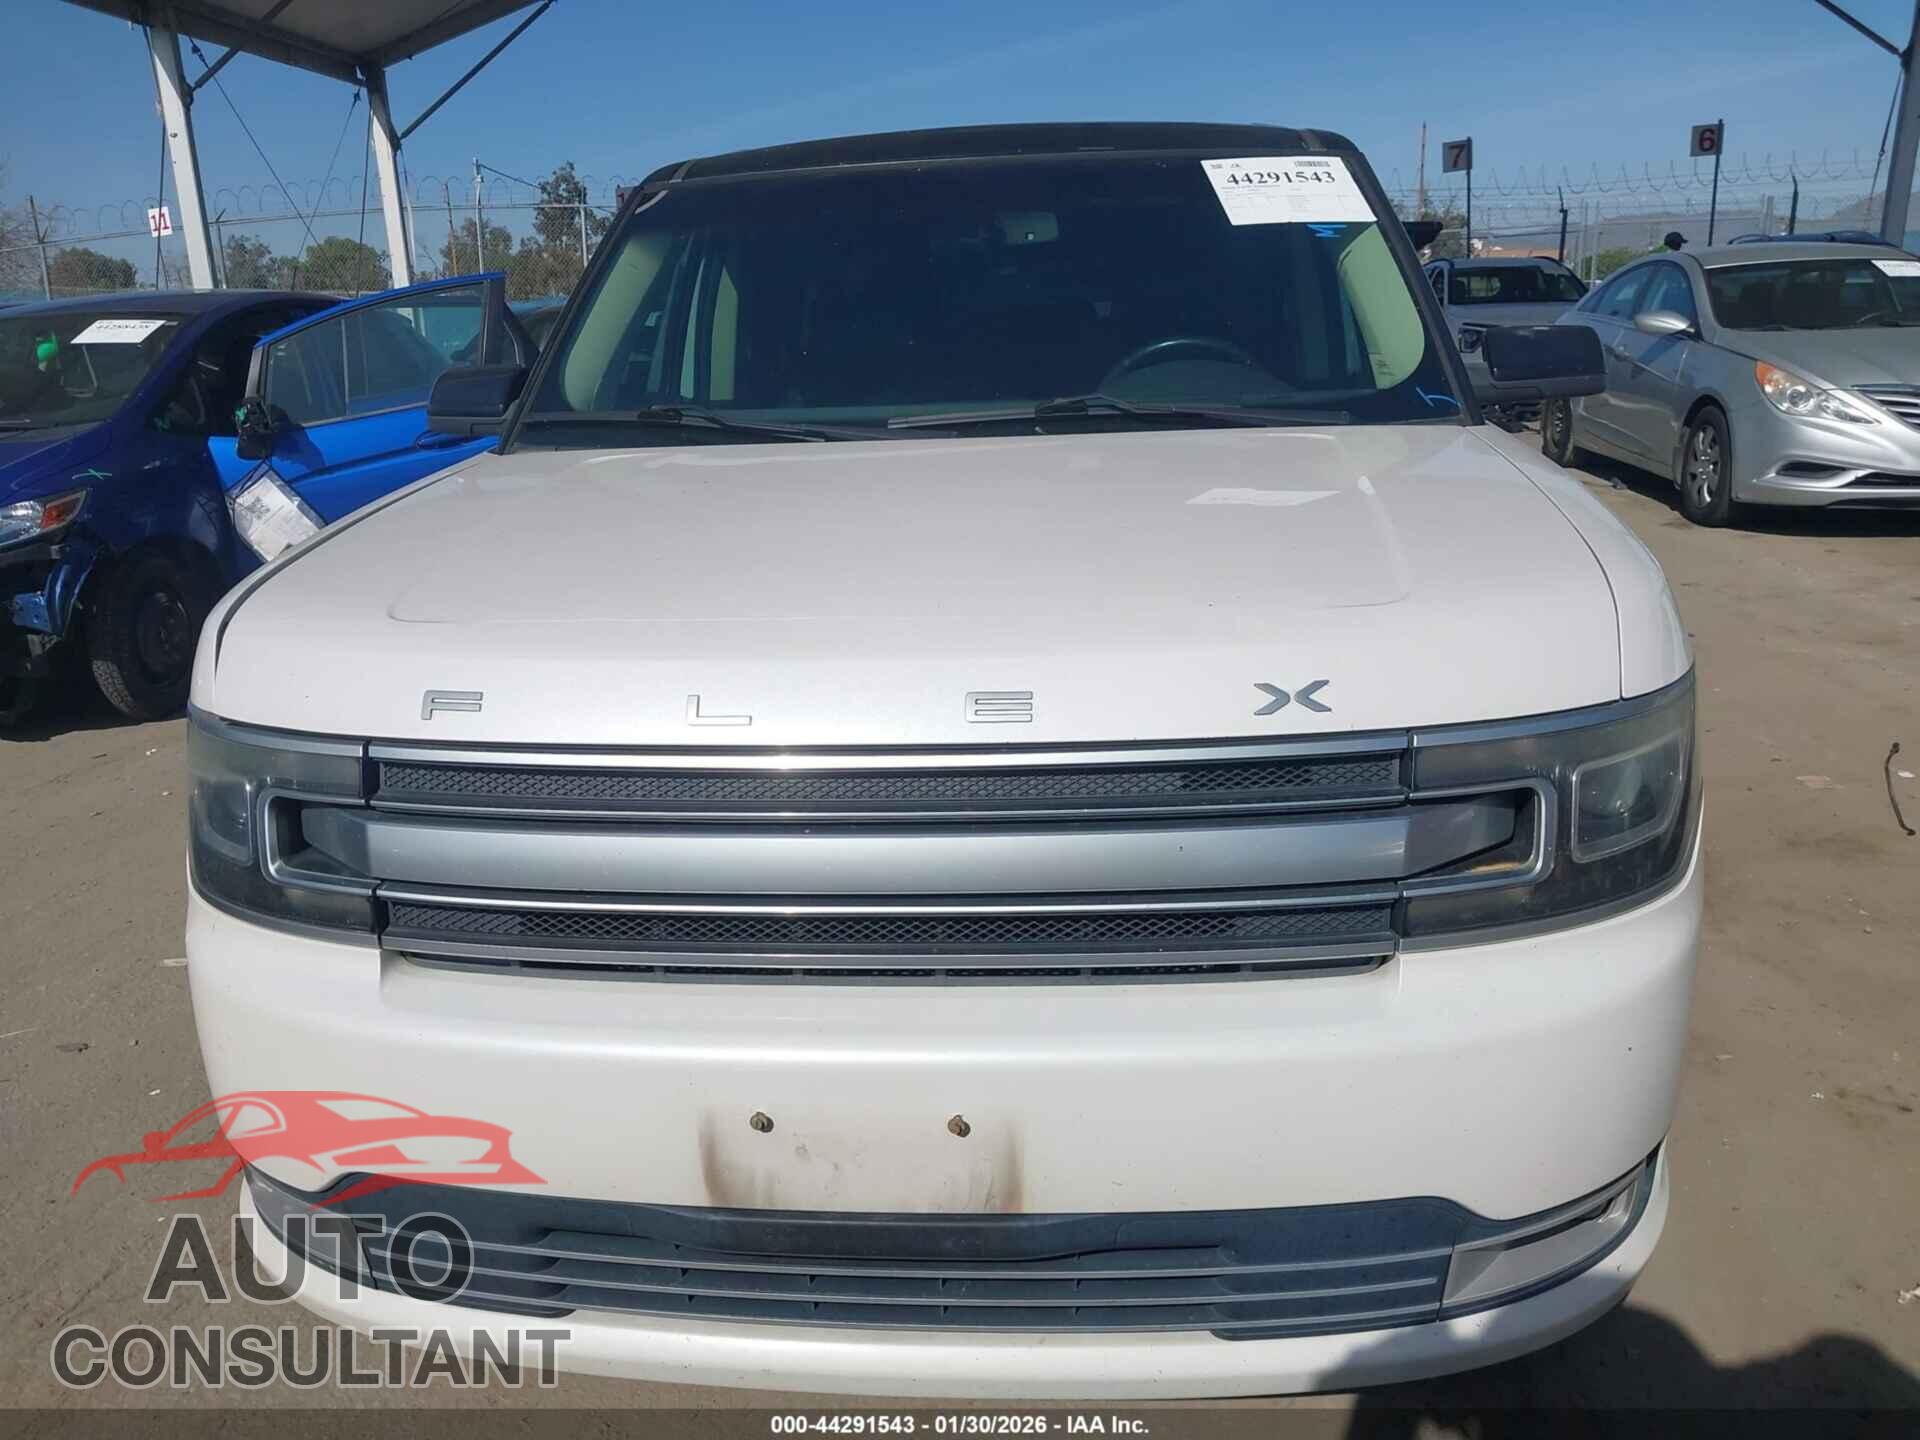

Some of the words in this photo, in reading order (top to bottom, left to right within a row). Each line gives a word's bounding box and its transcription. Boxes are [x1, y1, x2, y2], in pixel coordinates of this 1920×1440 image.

[1699, 128, 1716, 152] 6
[1448, 143, 1467, 169] 7
[1226, 171, 1336, 185] 44291543
[150, 212, 170, 232] 11
